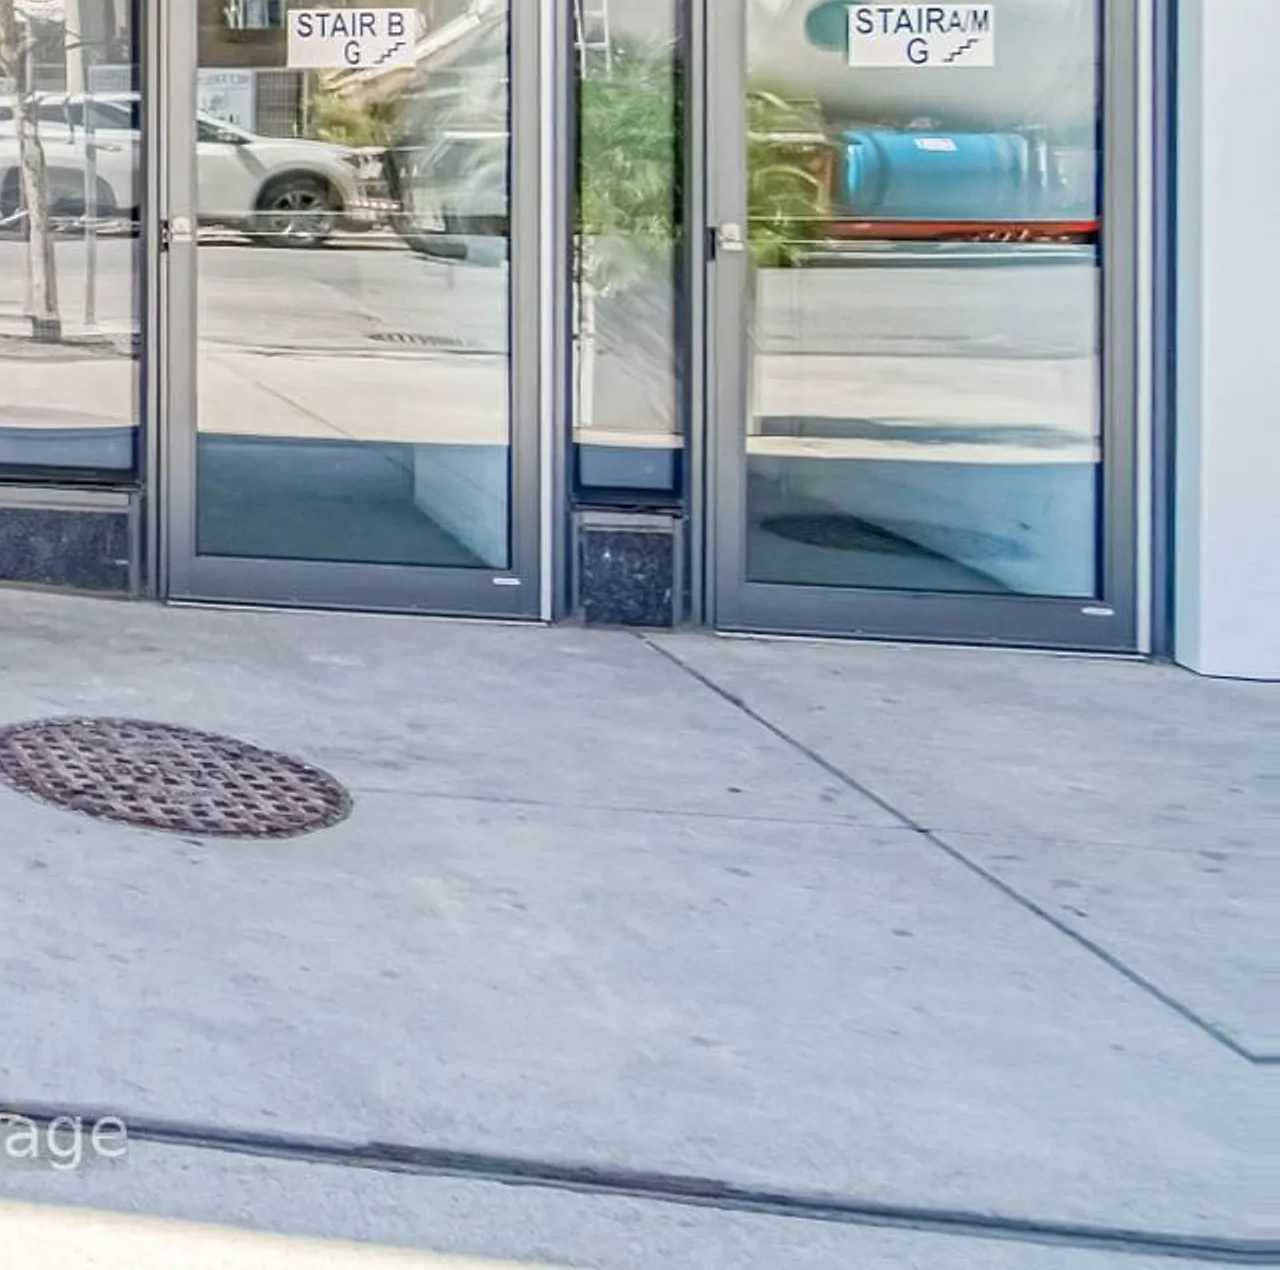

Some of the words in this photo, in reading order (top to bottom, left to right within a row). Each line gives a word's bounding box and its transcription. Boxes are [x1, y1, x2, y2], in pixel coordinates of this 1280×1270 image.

[297, 12, 376, 38] STAIR
[388, 12, 405, 37] B
[344, 40, 361, 65] G
[907, 37, 929, 65] G
